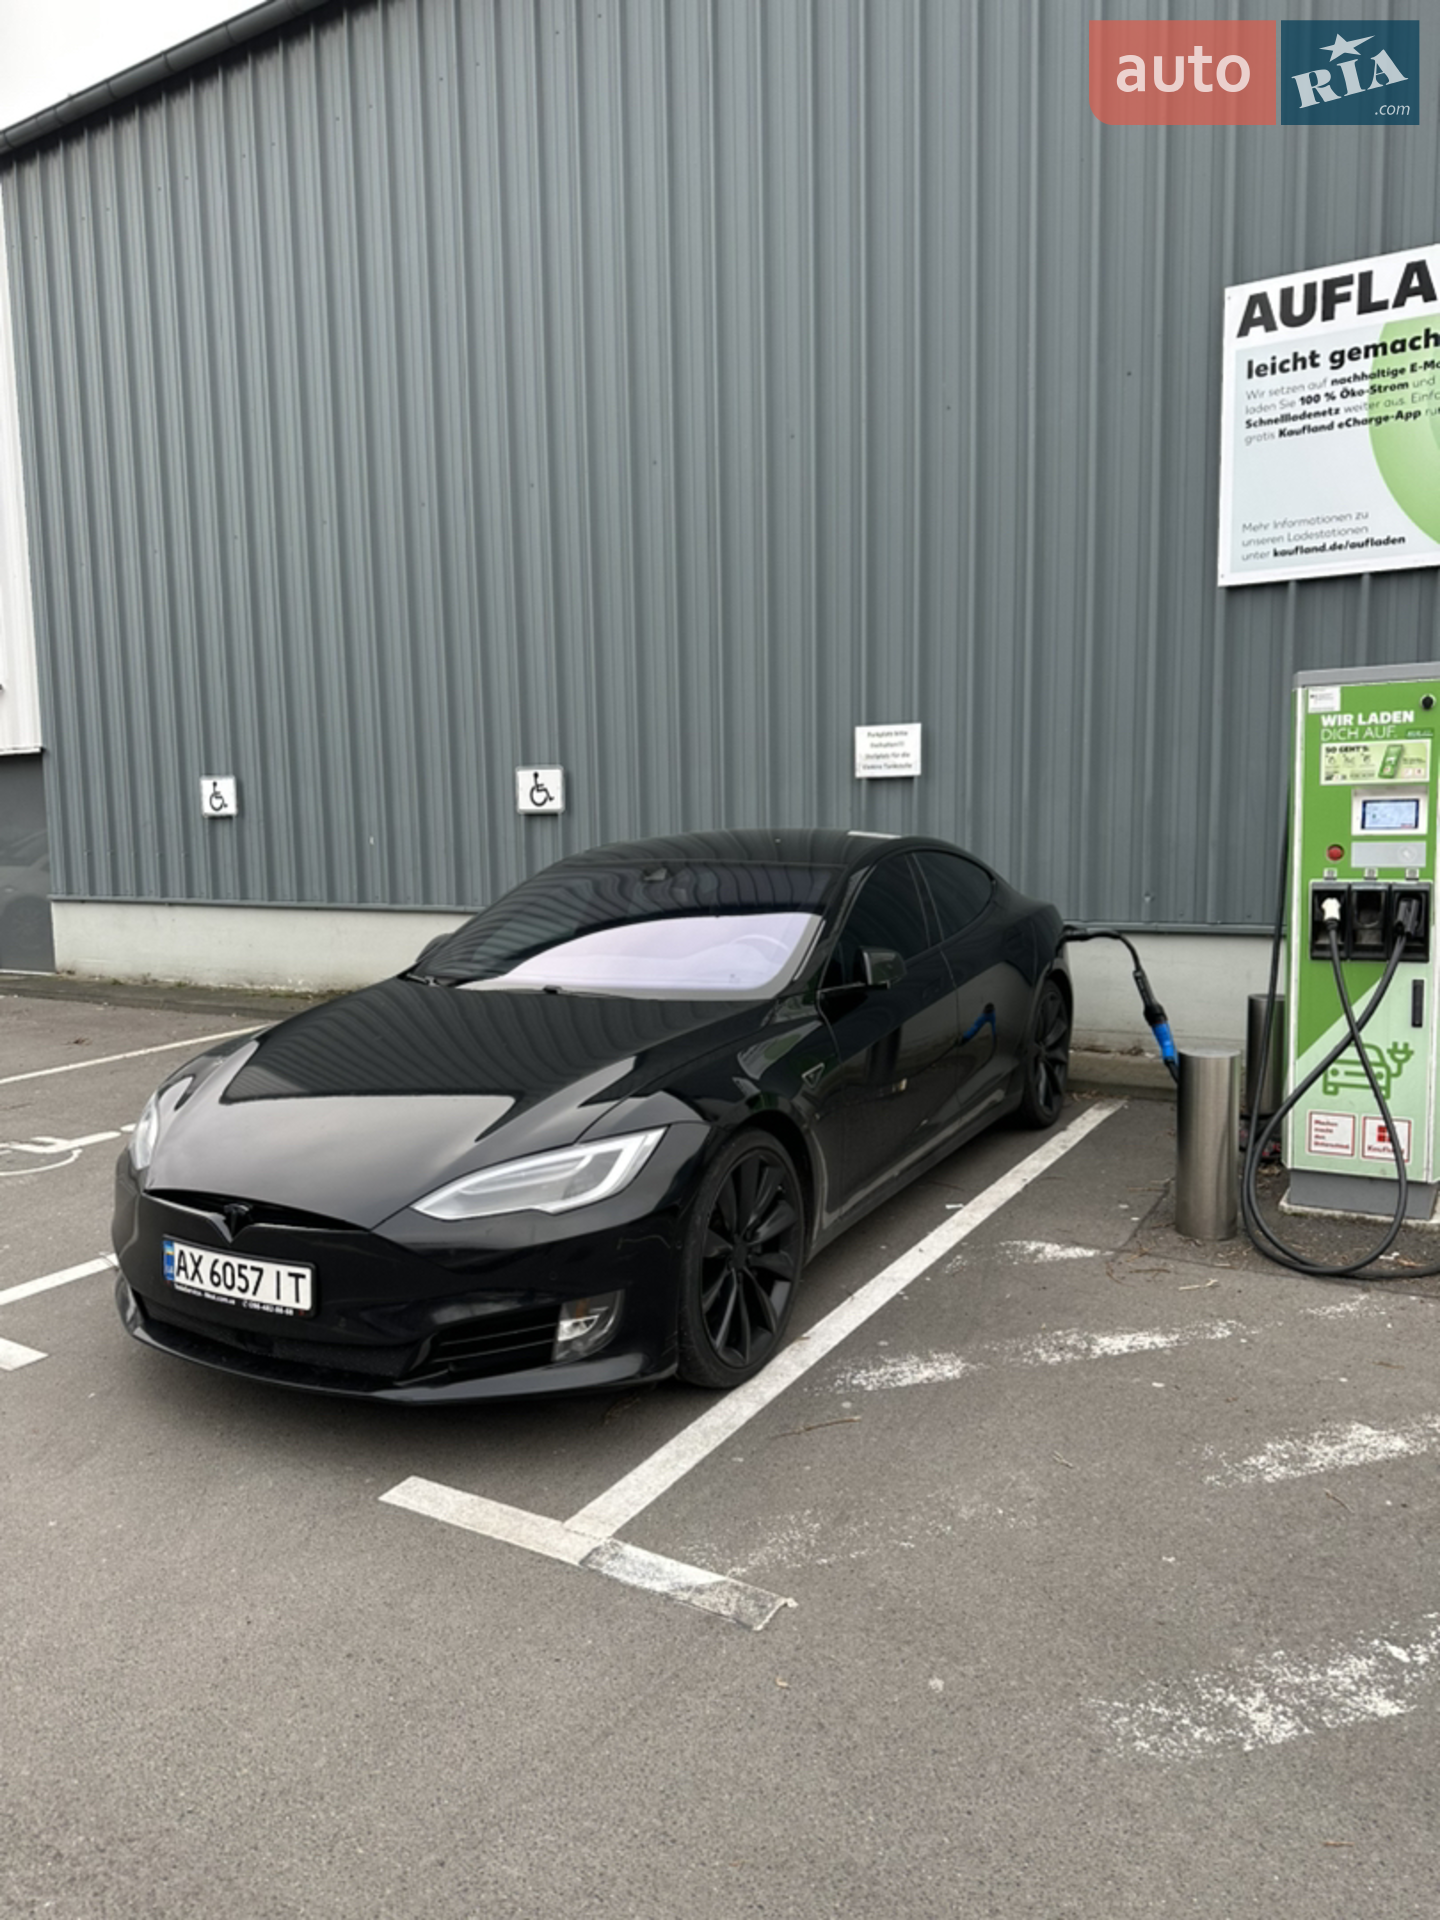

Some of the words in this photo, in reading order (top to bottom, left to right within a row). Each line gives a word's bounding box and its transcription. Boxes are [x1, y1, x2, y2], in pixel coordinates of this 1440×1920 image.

[1236, 259, 1439, 339] AUFLA
[1247, 350, 1321, 380] leicht
[1329, 327, 1440, 371] gemach
[1245, 389, 1266, 401] Wir
[1268, 382, 1306, 397] setzen
[1307, 379, 1328, 392] auf
[1331, 365, 1407, 387] nachhaltige
[1245, 402, 1277, 415] laden
[1279, 398, 1297, 409] Sie
[1300, 393, 1321, 406] 100
[1324, 391, 1336, 402] %
[1340, 380, 1409, 400] Öko-Strom
[1412, 375, 1436, 389] und
[1244, 430, 1276, 446] gratis
[1278, 421, 1335, 439] Kaufland
[1337, 407, 1422, 430] eCharge-App
[1245, 407, 1340, 430] Schnellladenetz
[1344, 397, 1380, 414] weiter
[1242, 522, 1270, 533] Mehr
[1273, 514, 1353, 530] Informationen
[1355, 511, 1369, 520] zu
[1242, 535, 1285, 547] unseren
[1287, 525, 1369, 542] Ladestationen
[1242, 549, 1270, 561] unter
[1273, 535, 1406, 558] kaufland.de/aufladen
[1321, 713, 1354, 727] WIR
[1357, 710, 1414, 725] LADEN
[1321, 727, 1359, 741] DICH
[1363, 725, 1398, 739] AUF.
[176, 1249, 203, 1284] AX
[209, 1258, 264, 1296] 6057
[276, 1270, 307, 1304] IT
